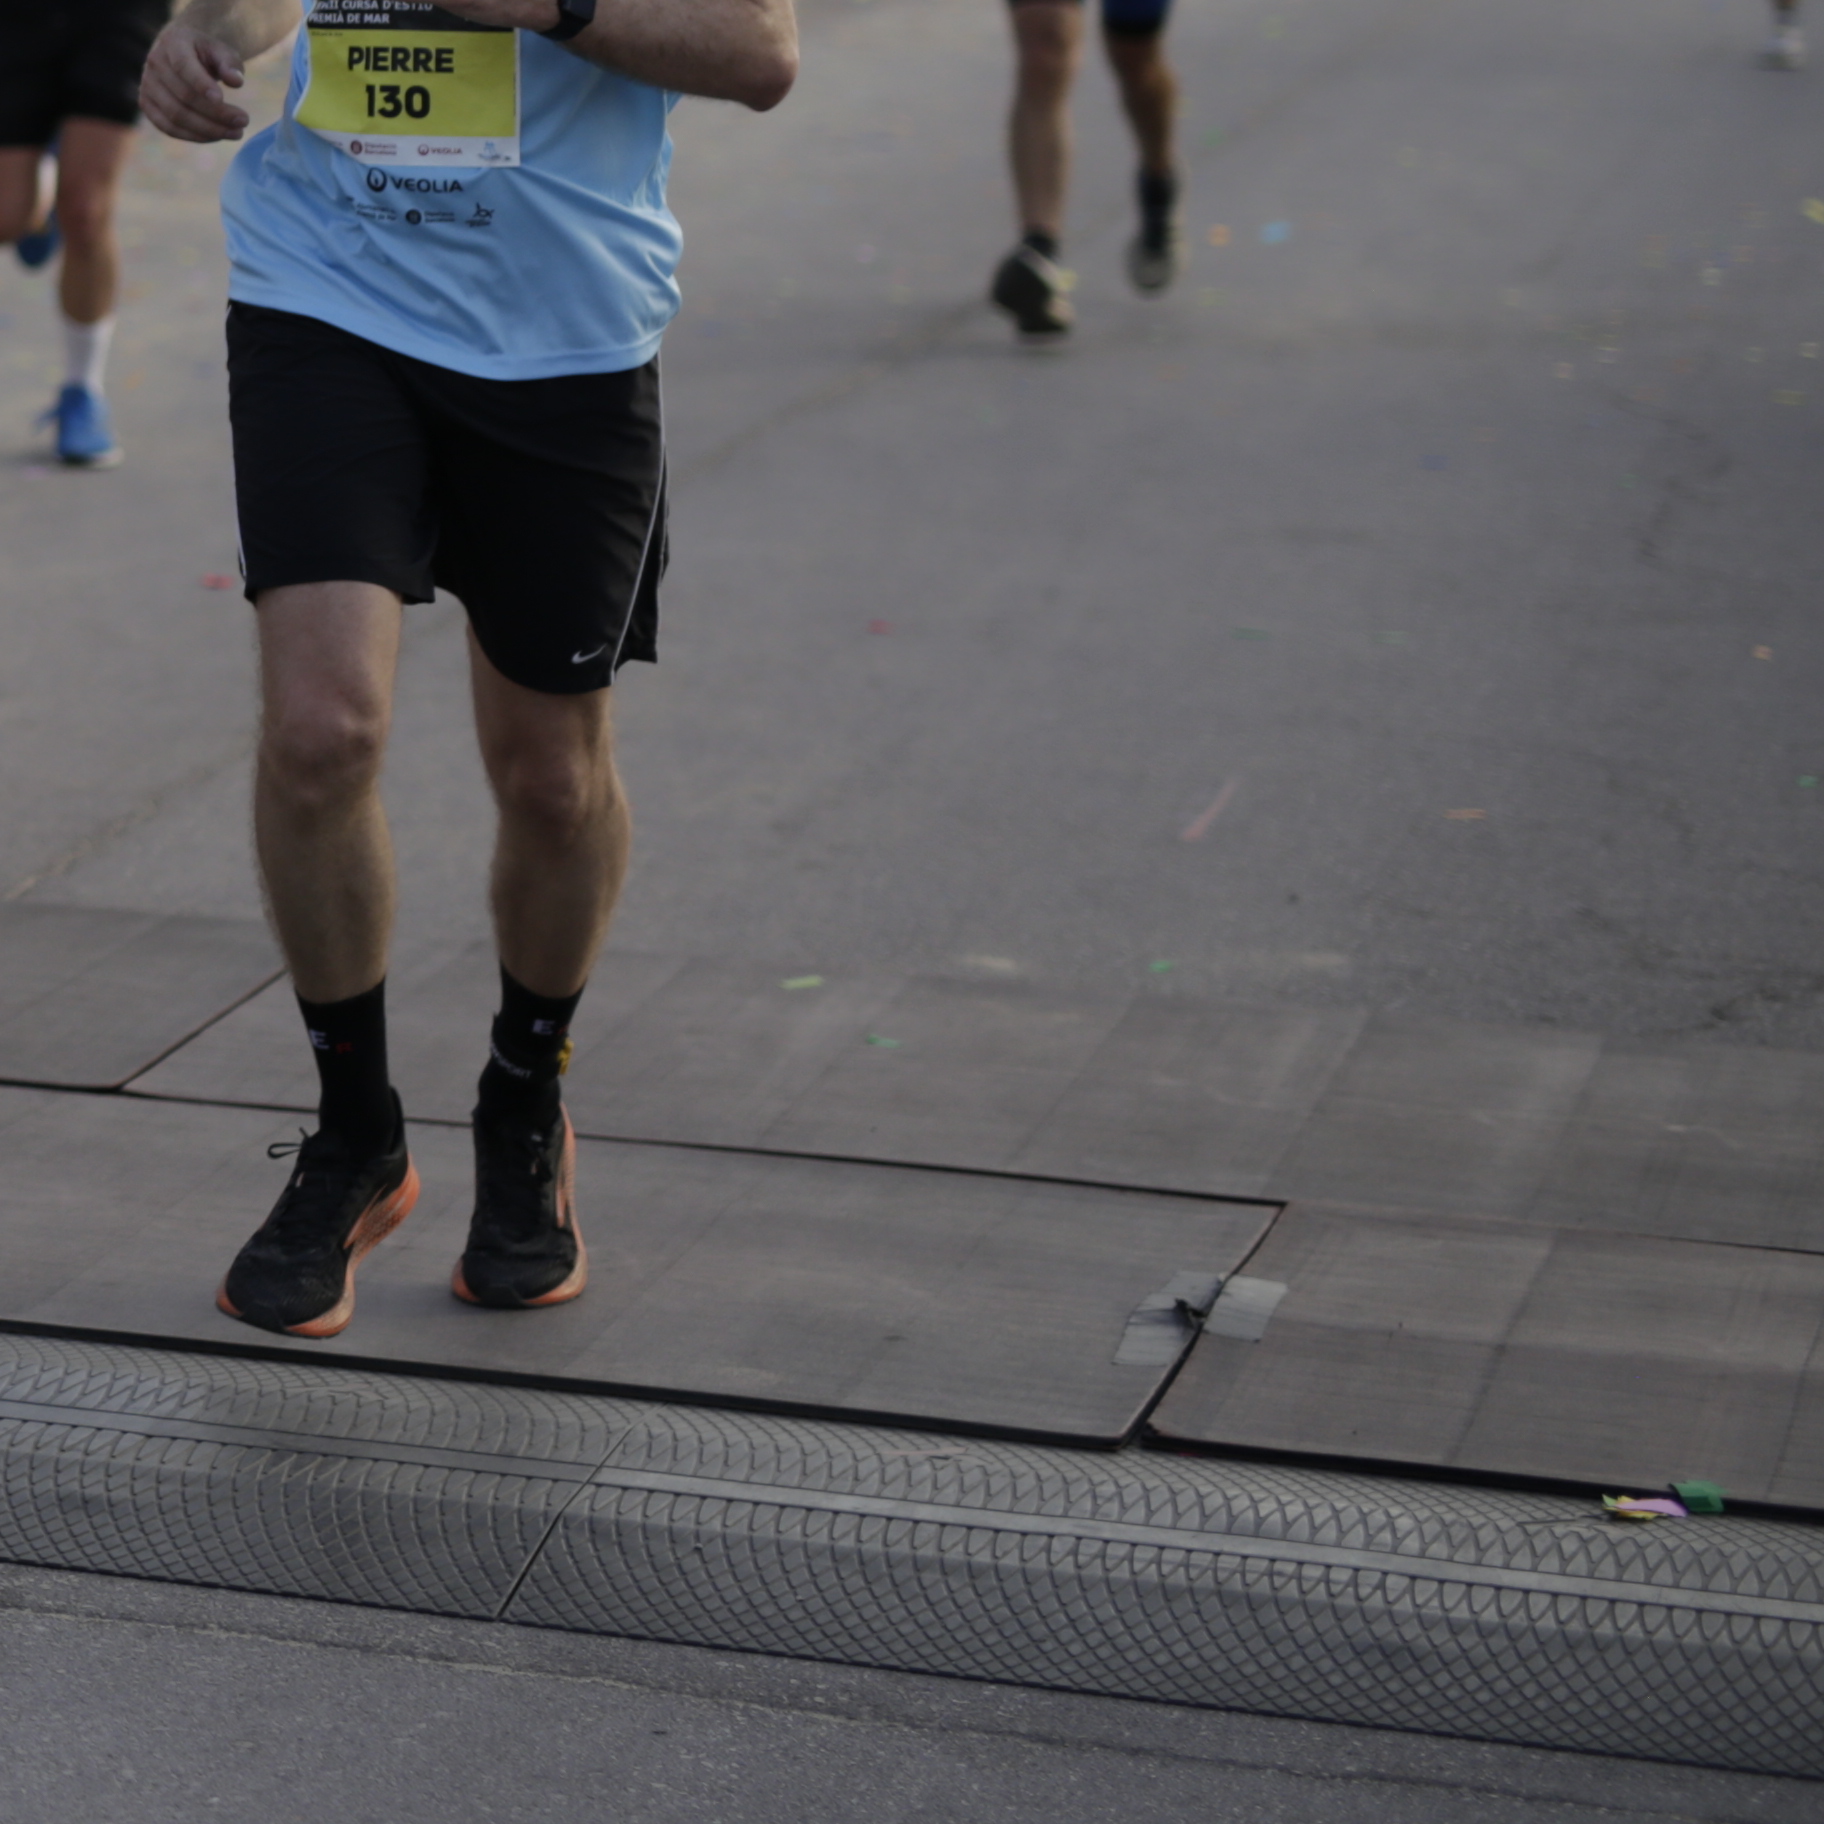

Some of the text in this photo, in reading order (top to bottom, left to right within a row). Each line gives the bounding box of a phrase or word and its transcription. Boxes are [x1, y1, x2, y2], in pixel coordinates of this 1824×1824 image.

[342, 0, 379, 11] CURSA
[347, 13, 361, 24] DE
[364, 13, 390, 24] MAR
[348, 46, 456, 73] PIERRE
[365, 84, 431, 119] 130
[390, 176, 464, 194] VEOLIA
